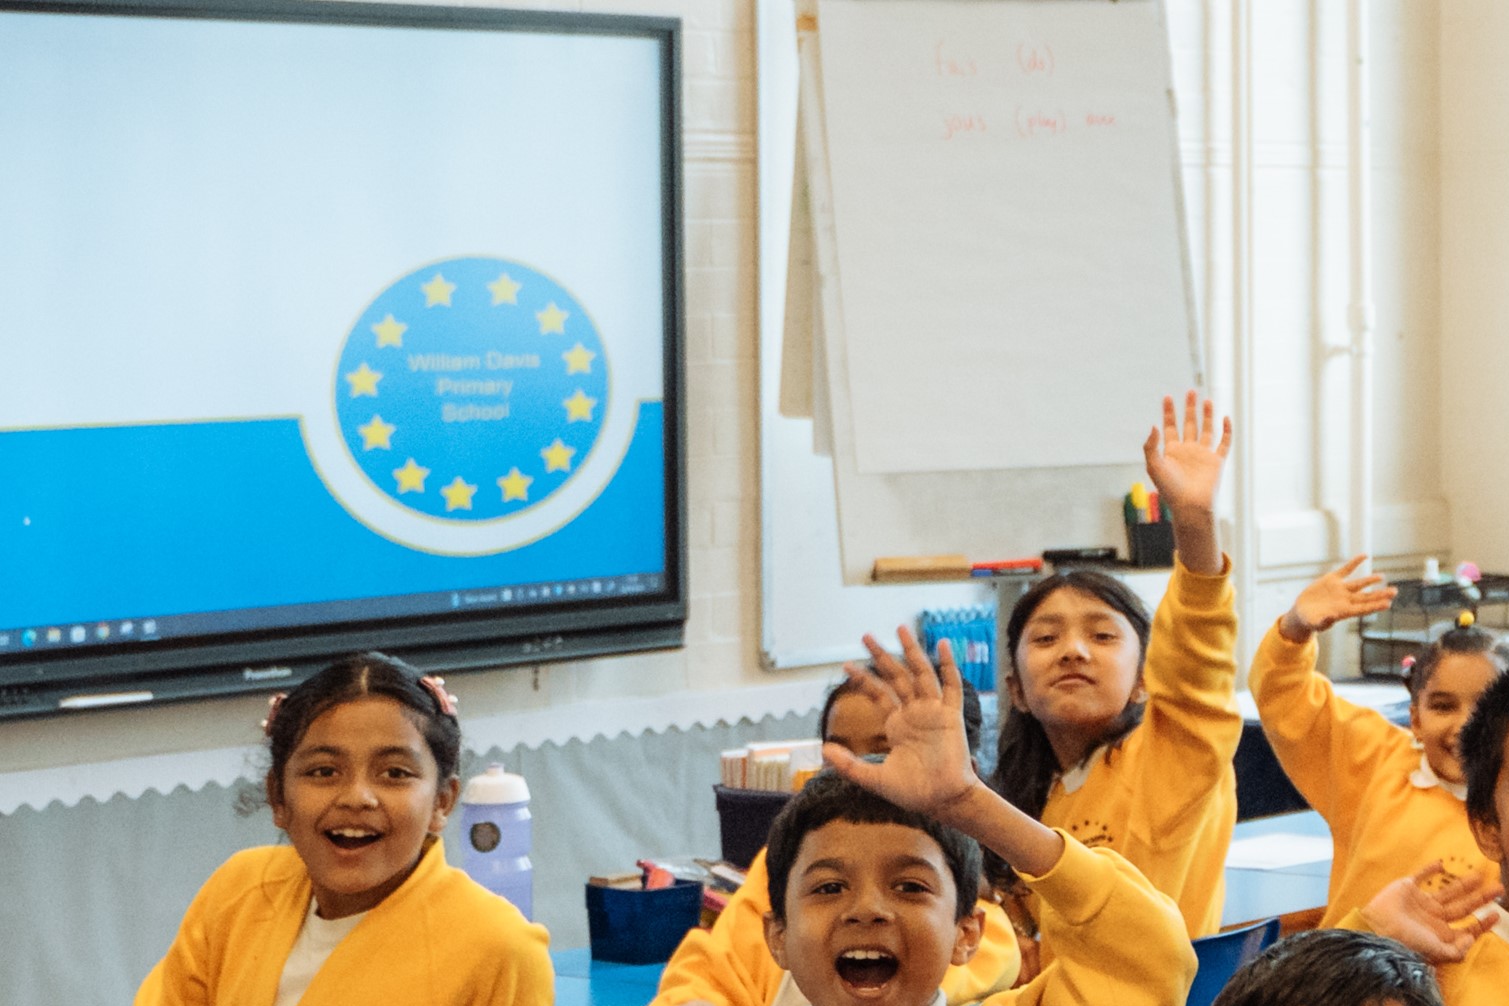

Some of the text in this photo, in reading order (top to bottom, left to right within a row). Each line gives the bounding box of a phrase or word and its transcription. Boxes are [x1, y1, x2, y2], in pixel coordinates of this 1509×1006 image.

[408, 349, 541, 373] William Davis
[435, 378, 513, 401] Primary
[442, 402, 511, 423] School
